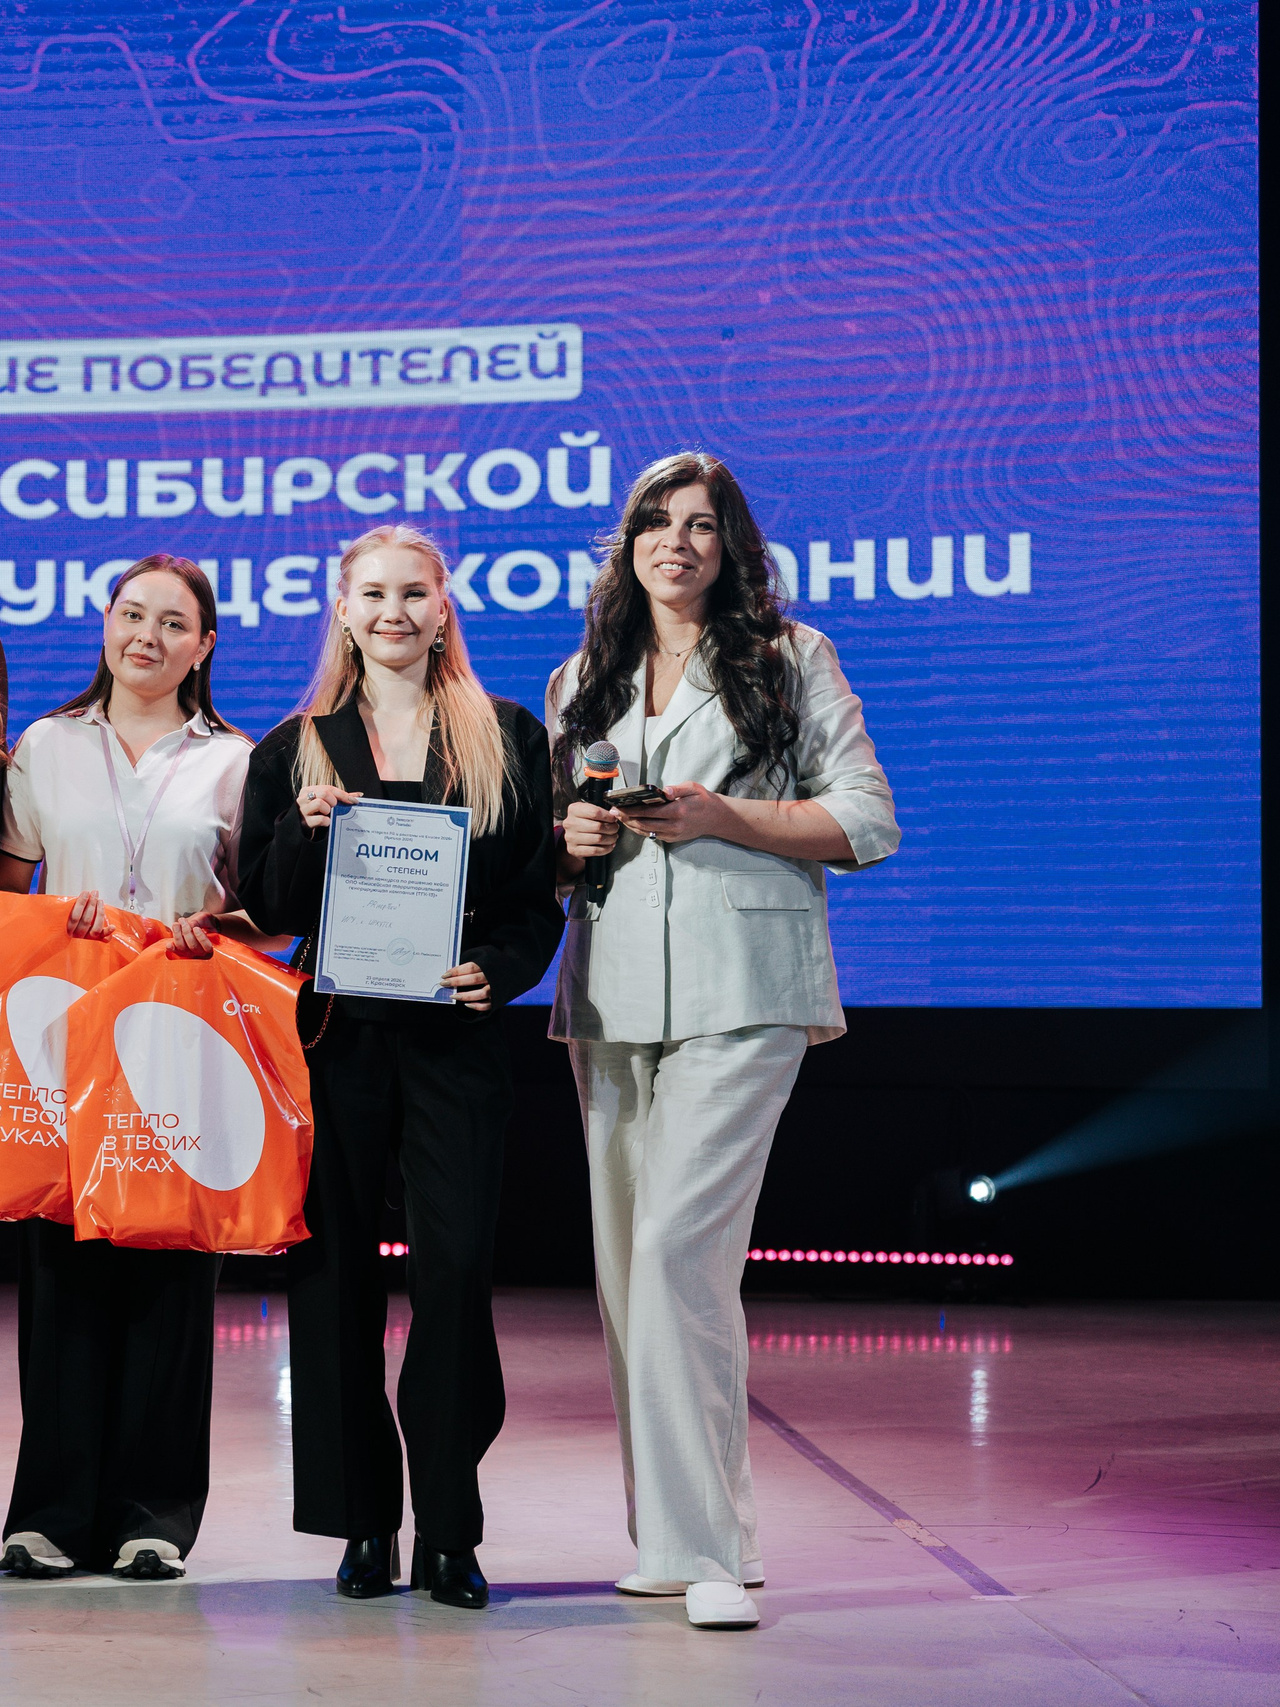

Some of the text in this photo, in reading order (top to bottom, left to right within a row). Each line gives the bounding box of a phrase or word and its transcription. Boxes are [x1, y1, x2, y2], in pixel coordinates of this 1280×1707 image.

[82, 331, 570, 397] ПОБЕДИТЕЛЕЙ
[356, 843, 439, 862] ДИПЛОМ
[386, 865, 429, 876] СТЕПЕНИ
[241, 1003, 262, 1015] СГК
[103, 1113, 180, 1129] ТЕПЛО
[103, 1134, 202, 1151] В ТВОИХ
[102, 1156, 175, 1173] РУКАХ
